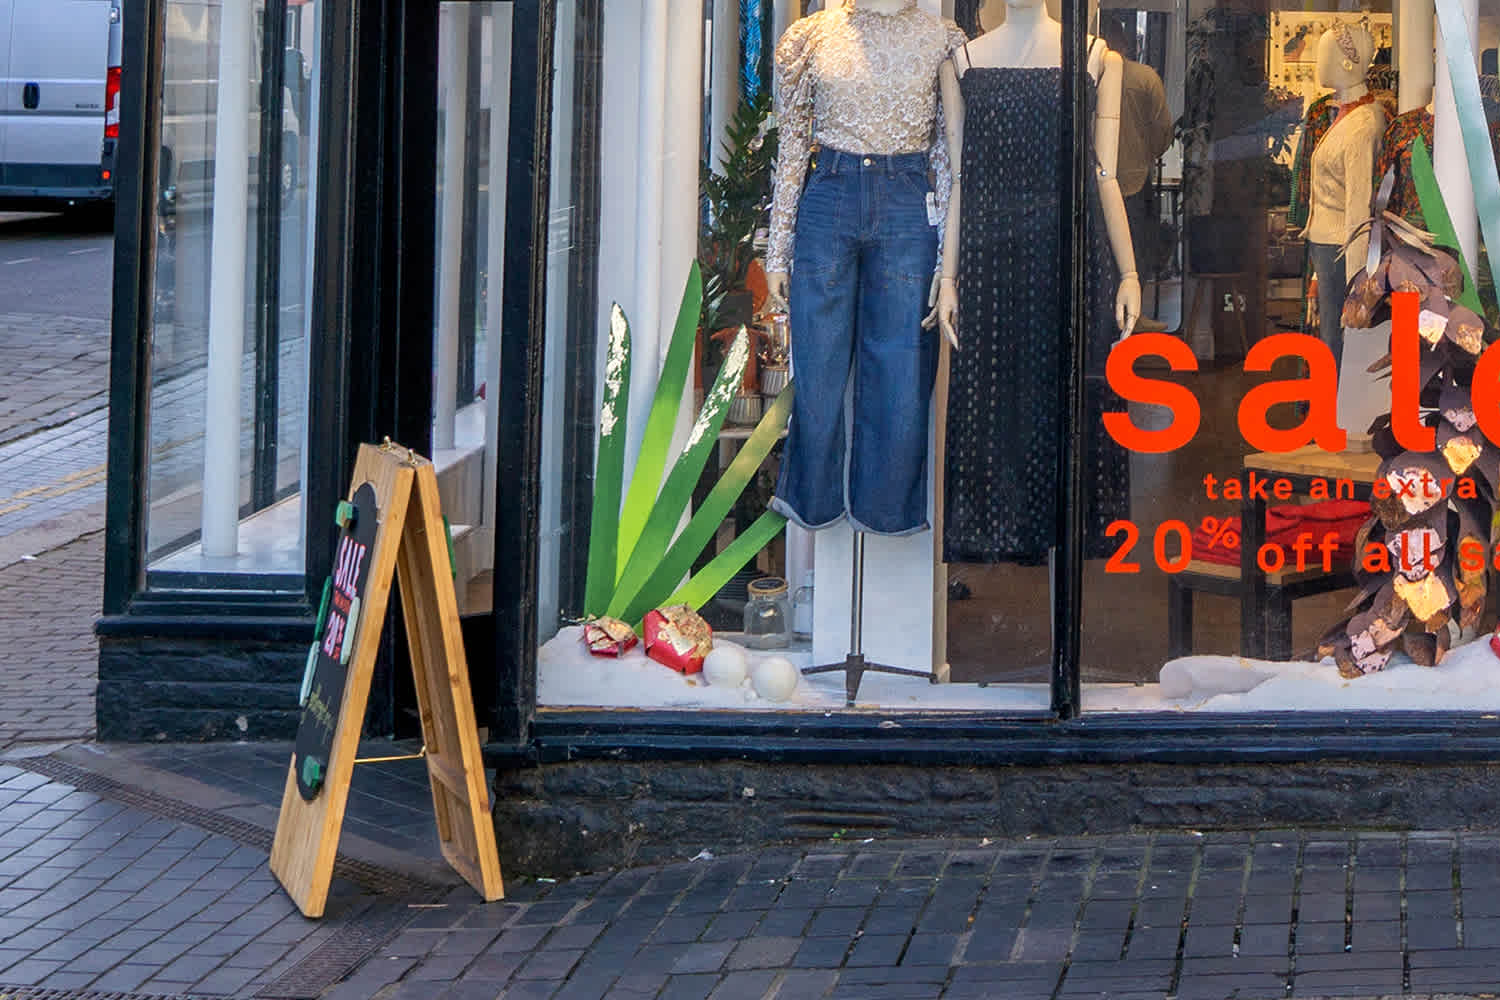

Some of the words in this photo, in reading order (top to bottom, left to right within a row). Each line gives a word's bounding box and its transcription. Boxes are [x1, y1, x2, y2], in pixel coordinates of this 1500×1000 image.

[1203, 471, 1293, 500] take
[1309, 479, 1355, 500] an
[1373, 474, 1477, 500] extra
[1104, 516, 1241, 574] 20%
[1257, 533, 1340, 573] off
[1363, 531, 1435, 573] all
